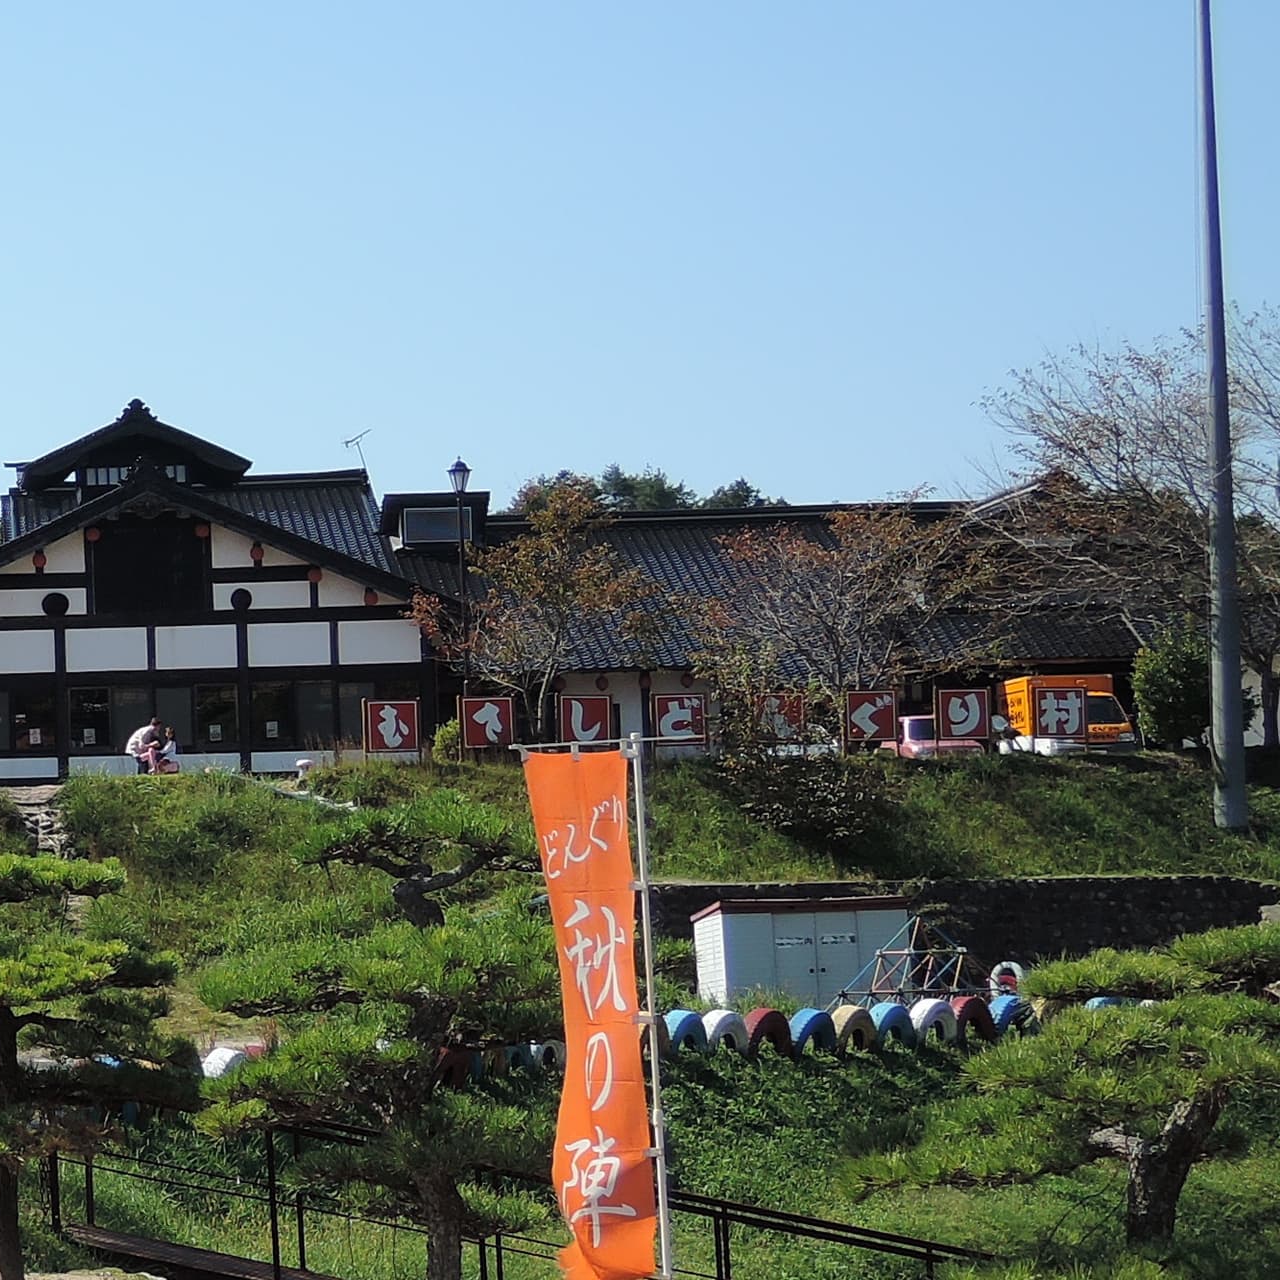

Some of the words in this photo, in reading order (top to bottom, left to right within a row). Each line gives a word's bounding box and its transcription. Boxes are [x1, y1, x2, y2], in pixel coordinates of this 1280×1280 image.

[542, 794, 624, 879] どんぐり
[561, 898, 637, 1249] 秋の陣
